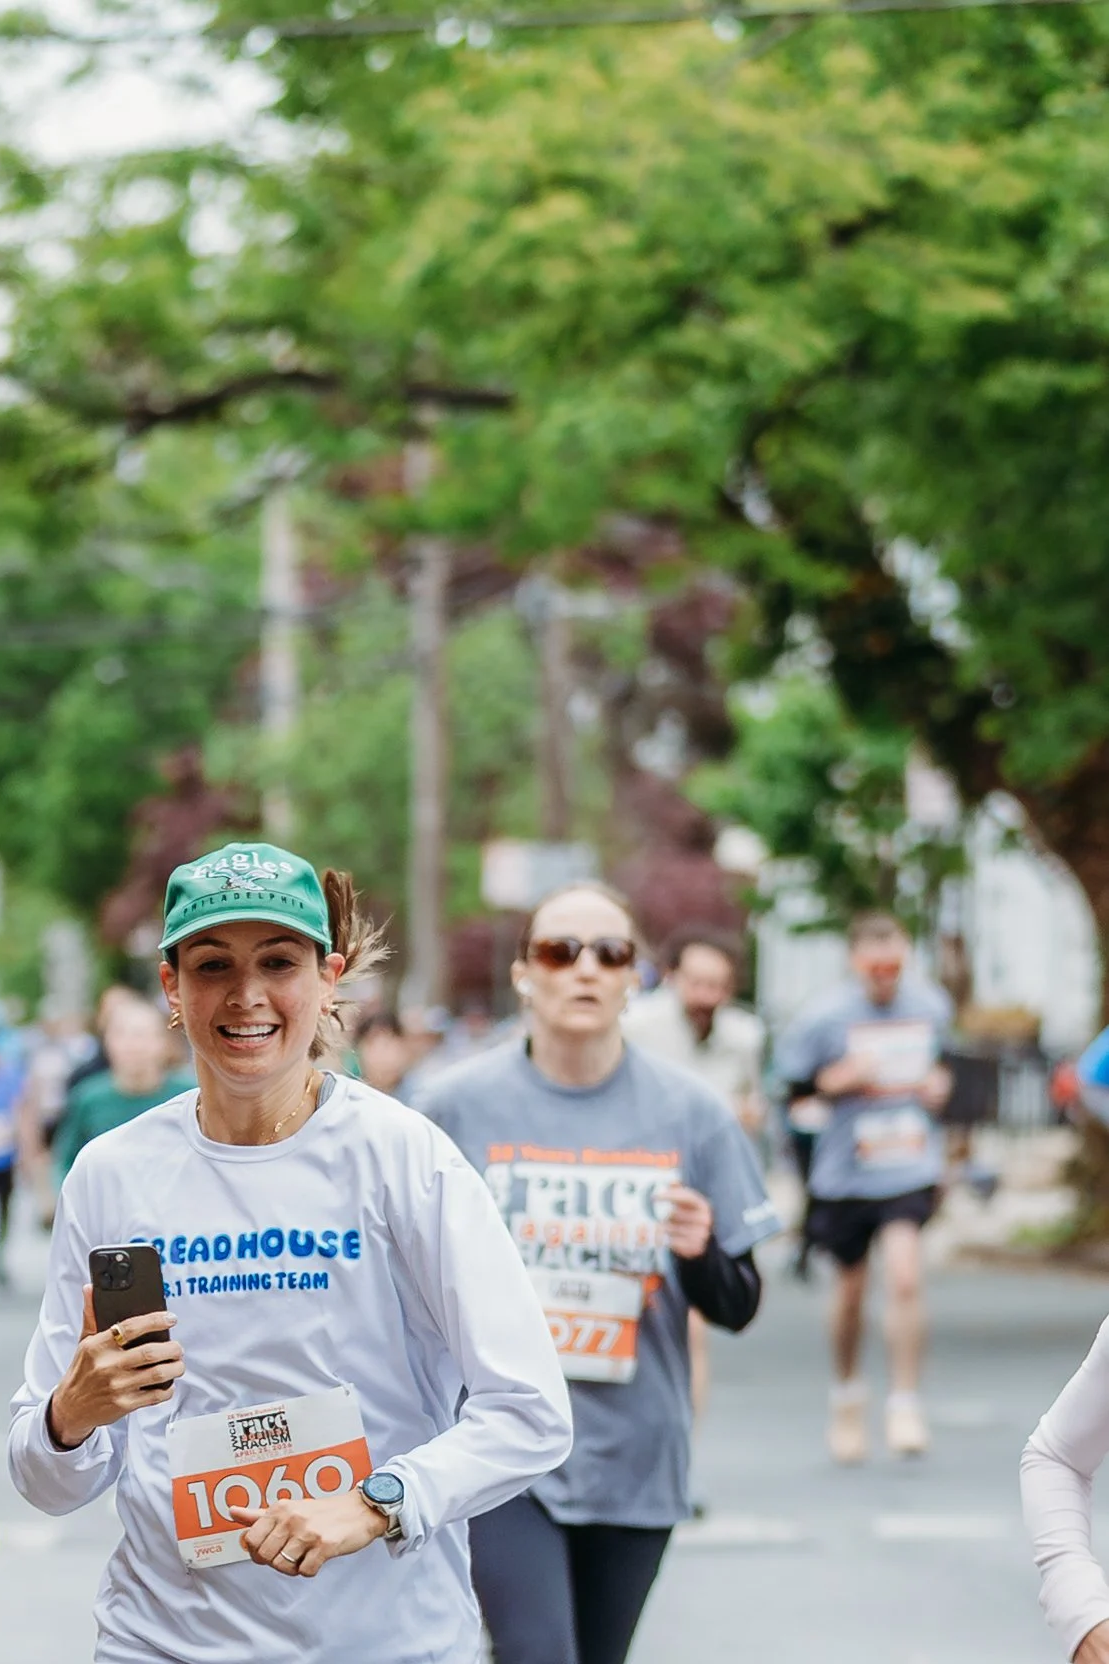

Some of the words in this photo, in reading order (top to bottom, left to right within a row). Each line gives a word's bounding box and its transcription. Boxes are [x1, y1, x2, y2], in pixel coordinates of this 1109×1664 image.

[190, 851, 294, 879] Eagles
[183, 892, 304, 916] PHILADELPHIA
[130, 1228, 361, 1264] READHOUSE
[187, 1273, 271, 1295] TRAINING
[275, 1271, 329, 1290] TEAM
[240, 1432, 292, 1451] RACISM
[187, 1455, 354, 1529] 1060
